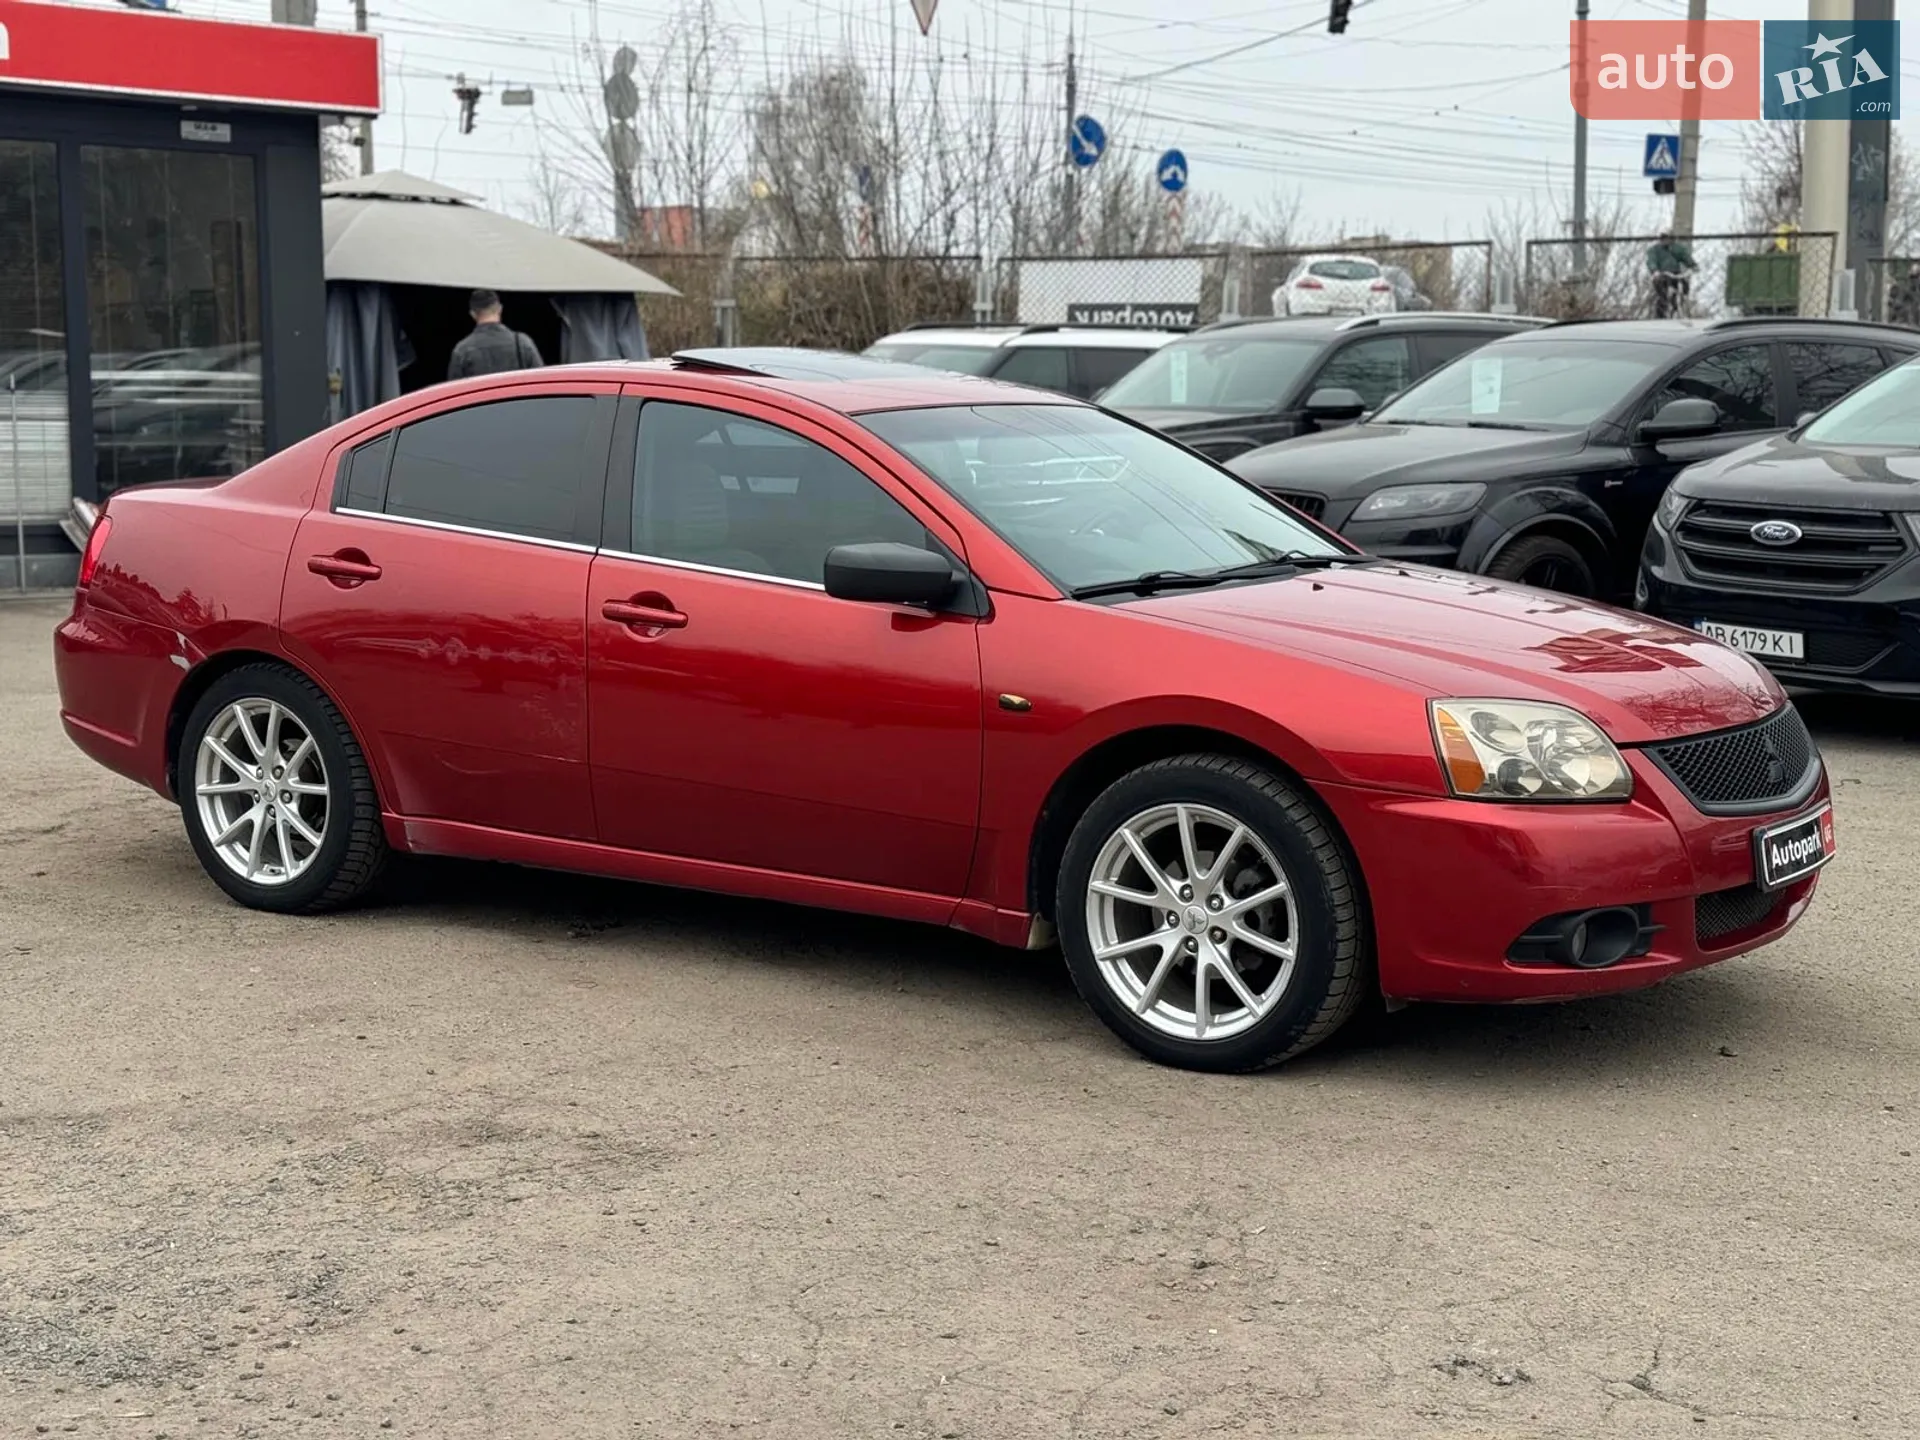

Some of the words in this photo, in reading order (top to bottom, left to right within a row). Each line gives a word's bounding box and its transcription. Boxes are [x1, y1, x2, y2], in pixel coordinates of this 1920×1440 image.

[1761, 525, 1788, 539] Ford
[1730, 629, 1767, 650] 6179
[1772, 633, 1793, 654] KI
[1772, 825, 1821, 869] Autopark
